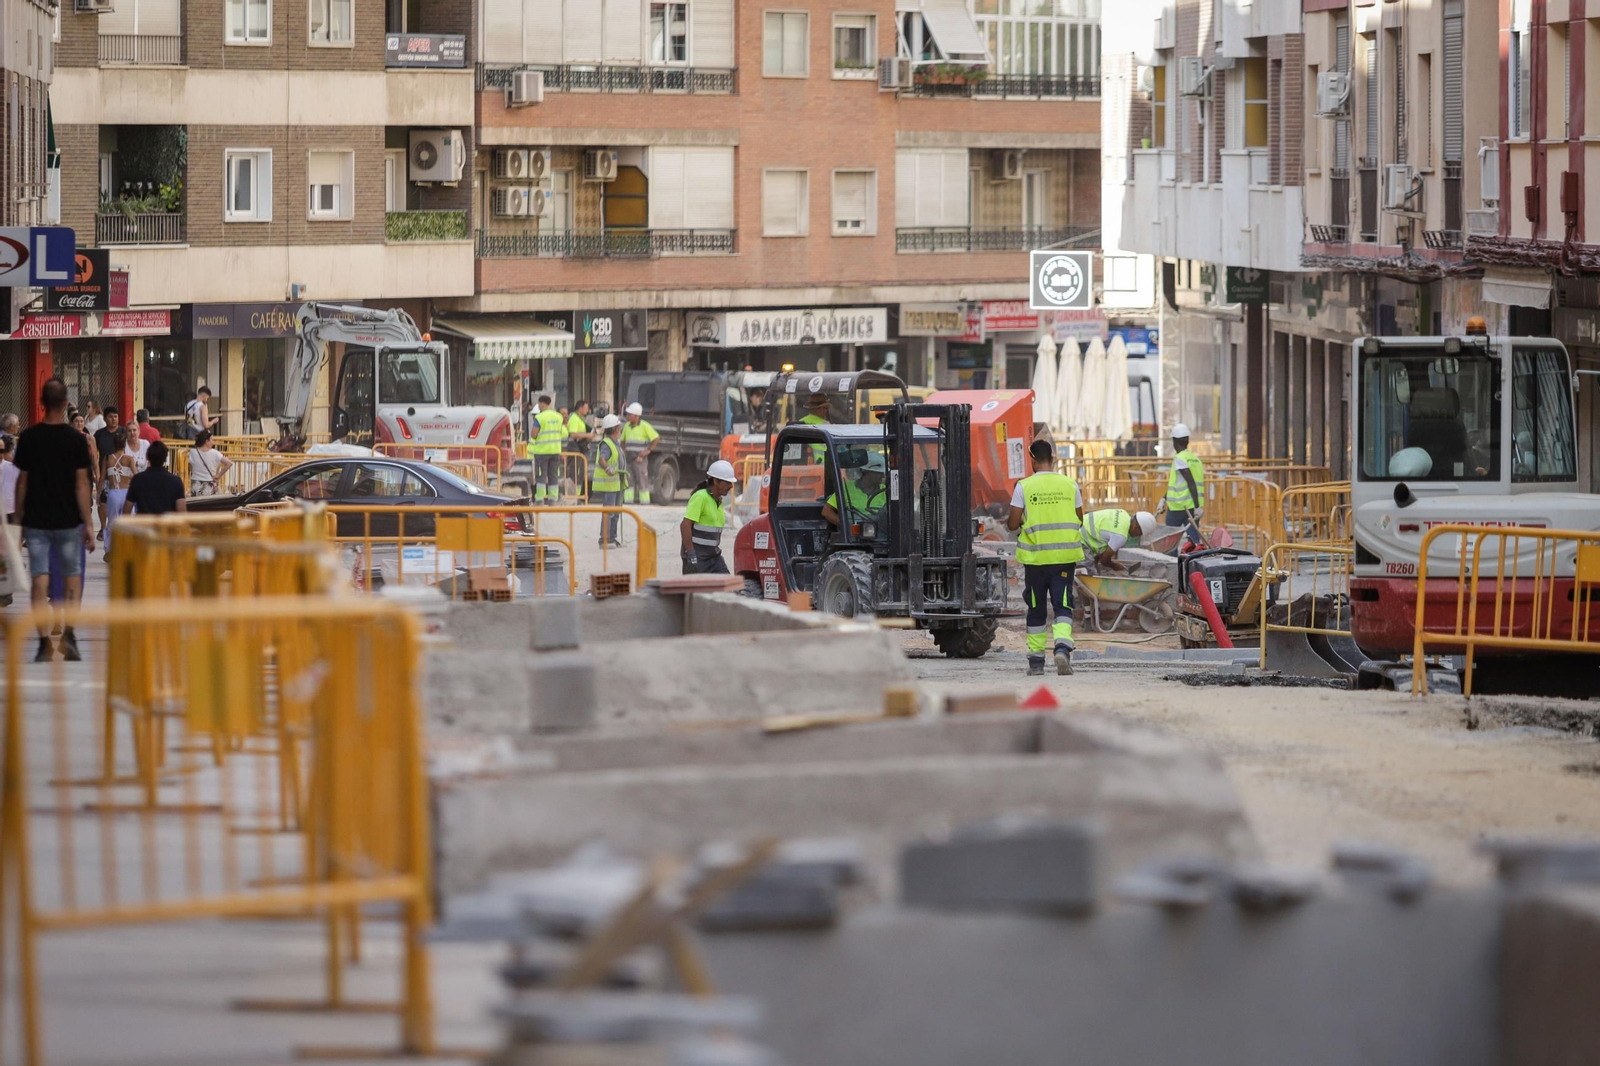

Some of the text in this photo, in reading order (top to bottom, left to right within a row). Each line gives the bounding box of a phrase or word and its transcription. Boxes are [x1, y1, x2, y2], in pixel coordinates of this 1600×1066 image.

[407, 38, 430, 52] APER
[36, 235, 68, 279] L
[108, 312, 125, 321] GESTIÓN
[148, 311, 166, 319] SERVICIOS
[141, 319, 166, 327] FINANCIEROS
[198, 315, 229, 326] PANADERÍA
[250, 308, 276, 329] CAFÉ
[22, 315, 75, 337] casamifar
[592, 317, 612, 336] CBD
[740, 316, 798, 343] ADACHI
[1385, 562, 1415, 575] TB260
